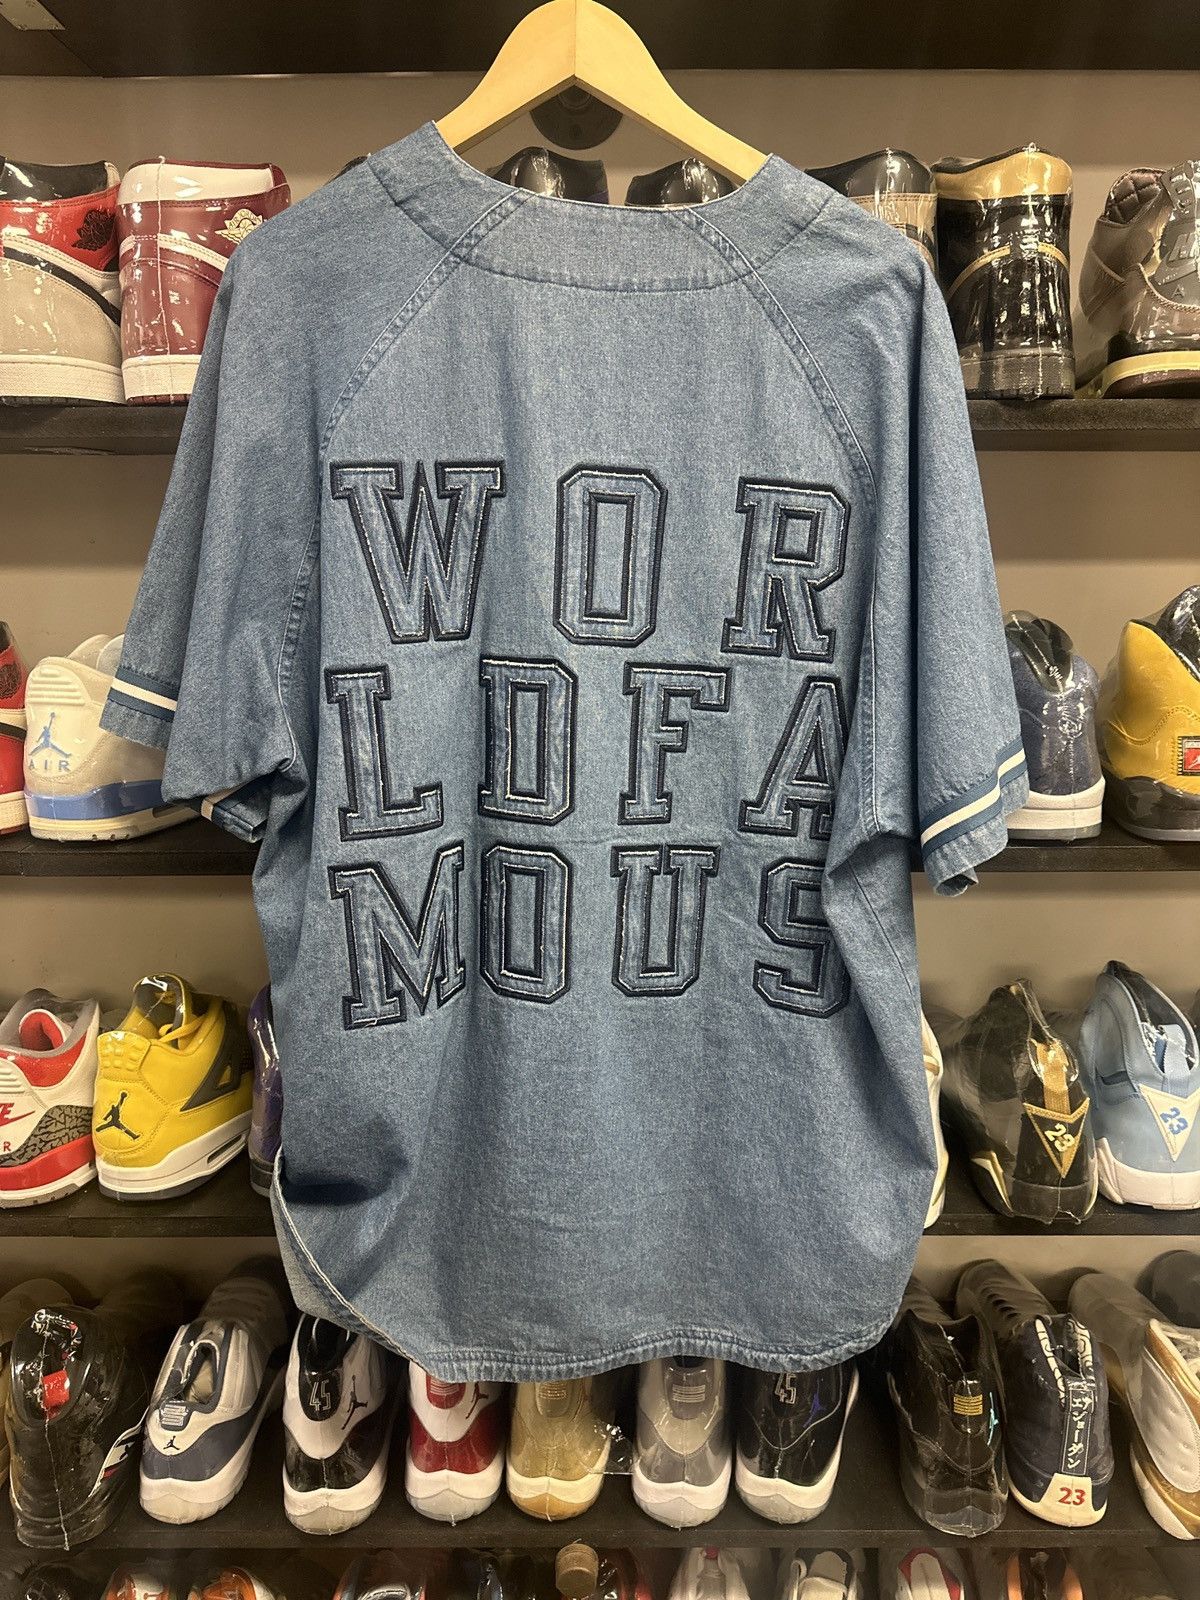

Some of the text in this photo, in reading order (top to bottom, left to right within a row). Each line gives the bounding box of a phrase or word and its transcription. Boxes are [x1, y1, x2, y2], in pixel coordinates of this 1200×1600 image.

[28, 759, 71, 772] AIR
[1160, 1107, 1188, 1135] 23
[1044, 1123, 1075, 1152] 23
[310, 1379, 331, 1411] 45
[775, 1371, 797, 1404] 45
[1058, 1487, 1086, 1506] 23
